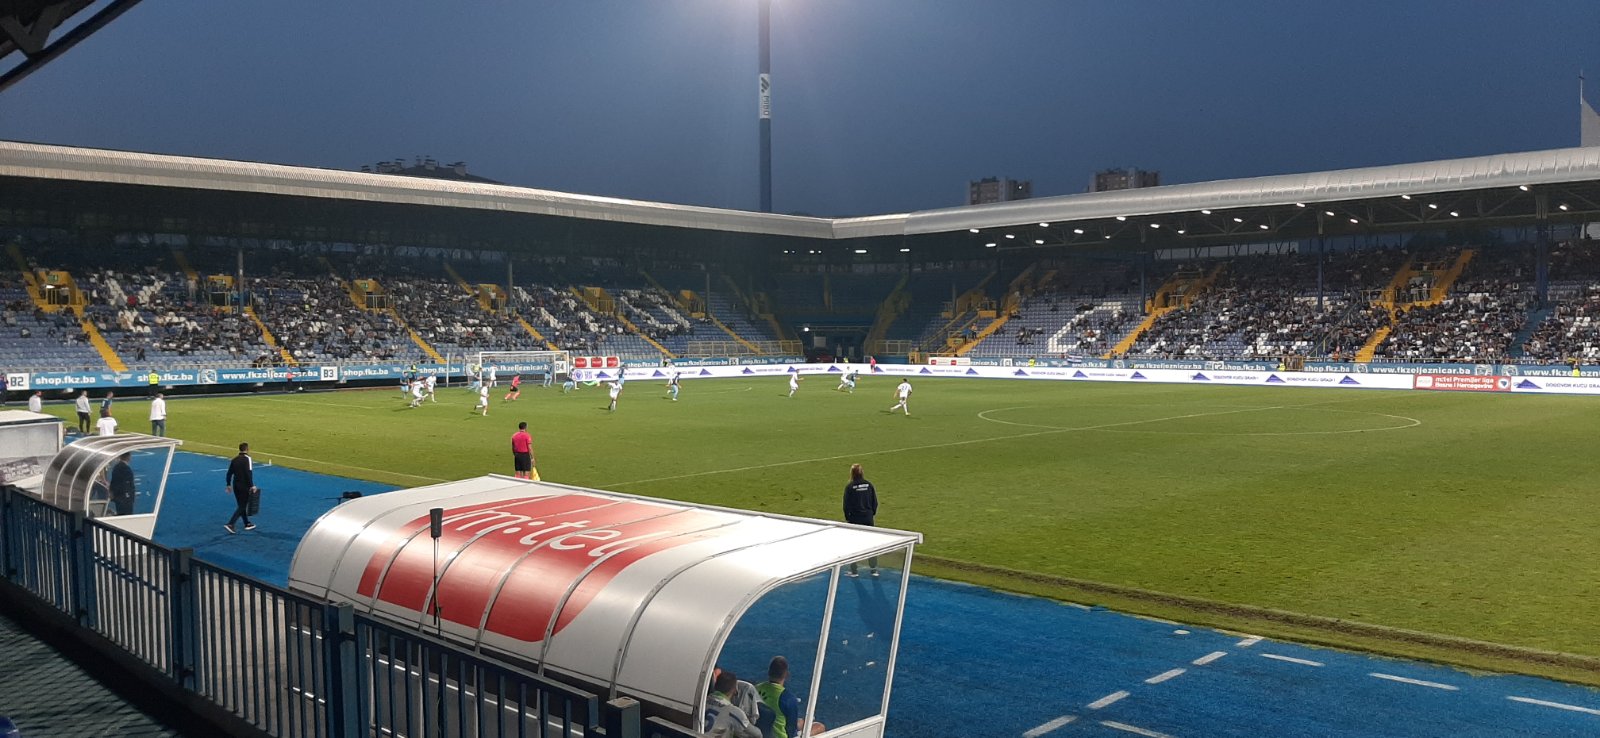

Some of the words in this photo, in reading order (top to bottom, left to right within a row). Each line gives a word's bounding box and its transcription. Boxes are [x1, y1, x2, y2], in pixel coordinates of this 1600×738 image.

[343, 368, 389, 377] shop.fkz.ba
[419, 366, 460, 375] shop.fk.ba
[1372, 366, 1471, 375] www.fkzeljeznicar.ba
[35, 376, 96, 385] shop.fkz.ba
[440, 510, 674, 558] m:tel
